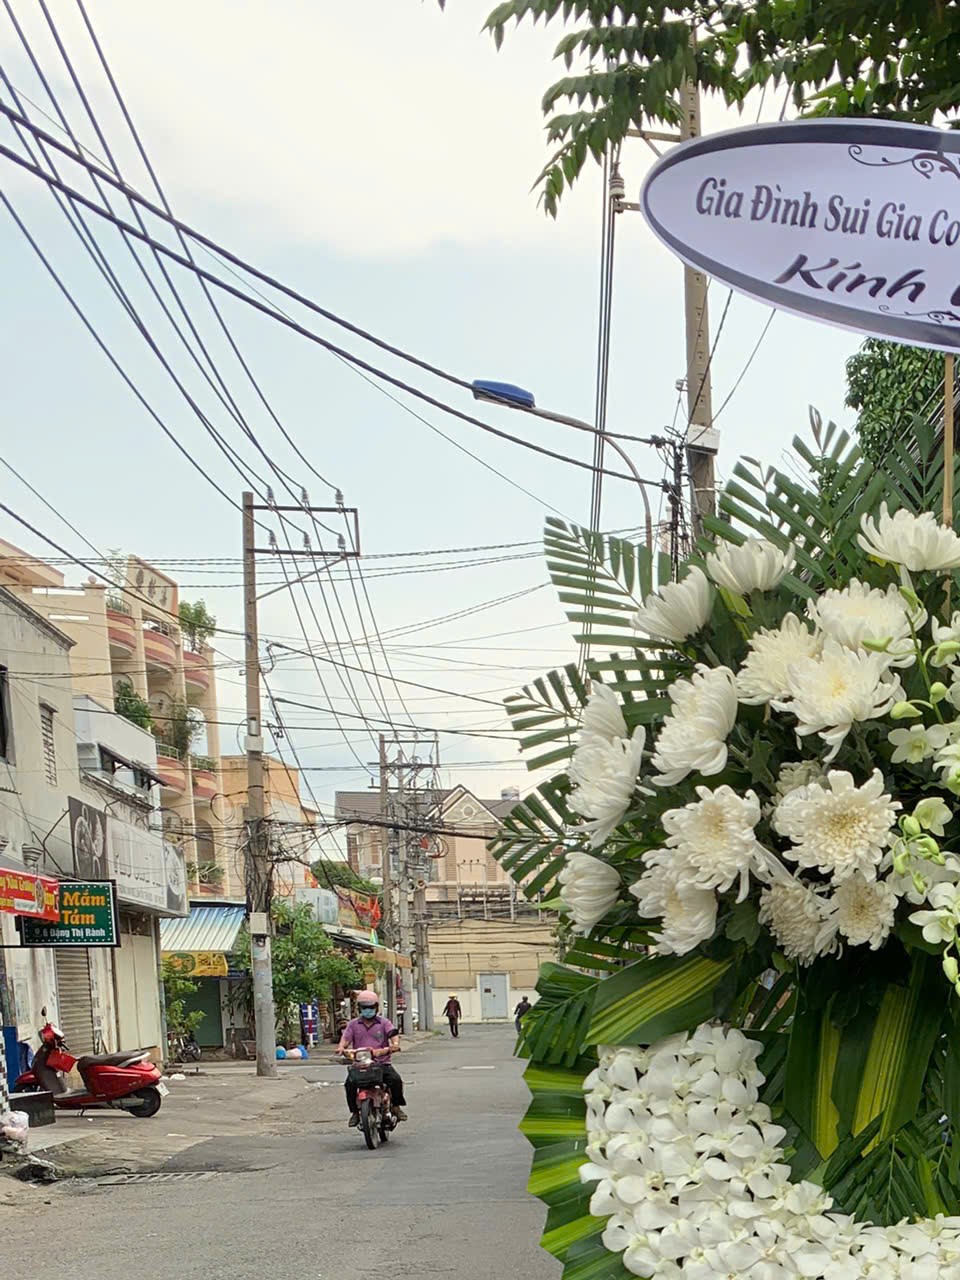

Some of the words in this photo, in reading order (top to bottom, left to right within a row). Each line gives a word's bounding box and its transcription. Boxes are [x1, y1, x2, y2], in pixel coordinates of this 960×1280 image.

[696, 177, 744, 219] Gia
[750, 184, 819, 228] Đình
[824, 194, 871, 235] Sui
[876, 202, 922, 241] Gia
[773, 253, 926, 303] Kính
[63, 889, 105, 906] Mắm
[62, 909, 96, 925] Tám
[71, 928, 84, 938] Thị
